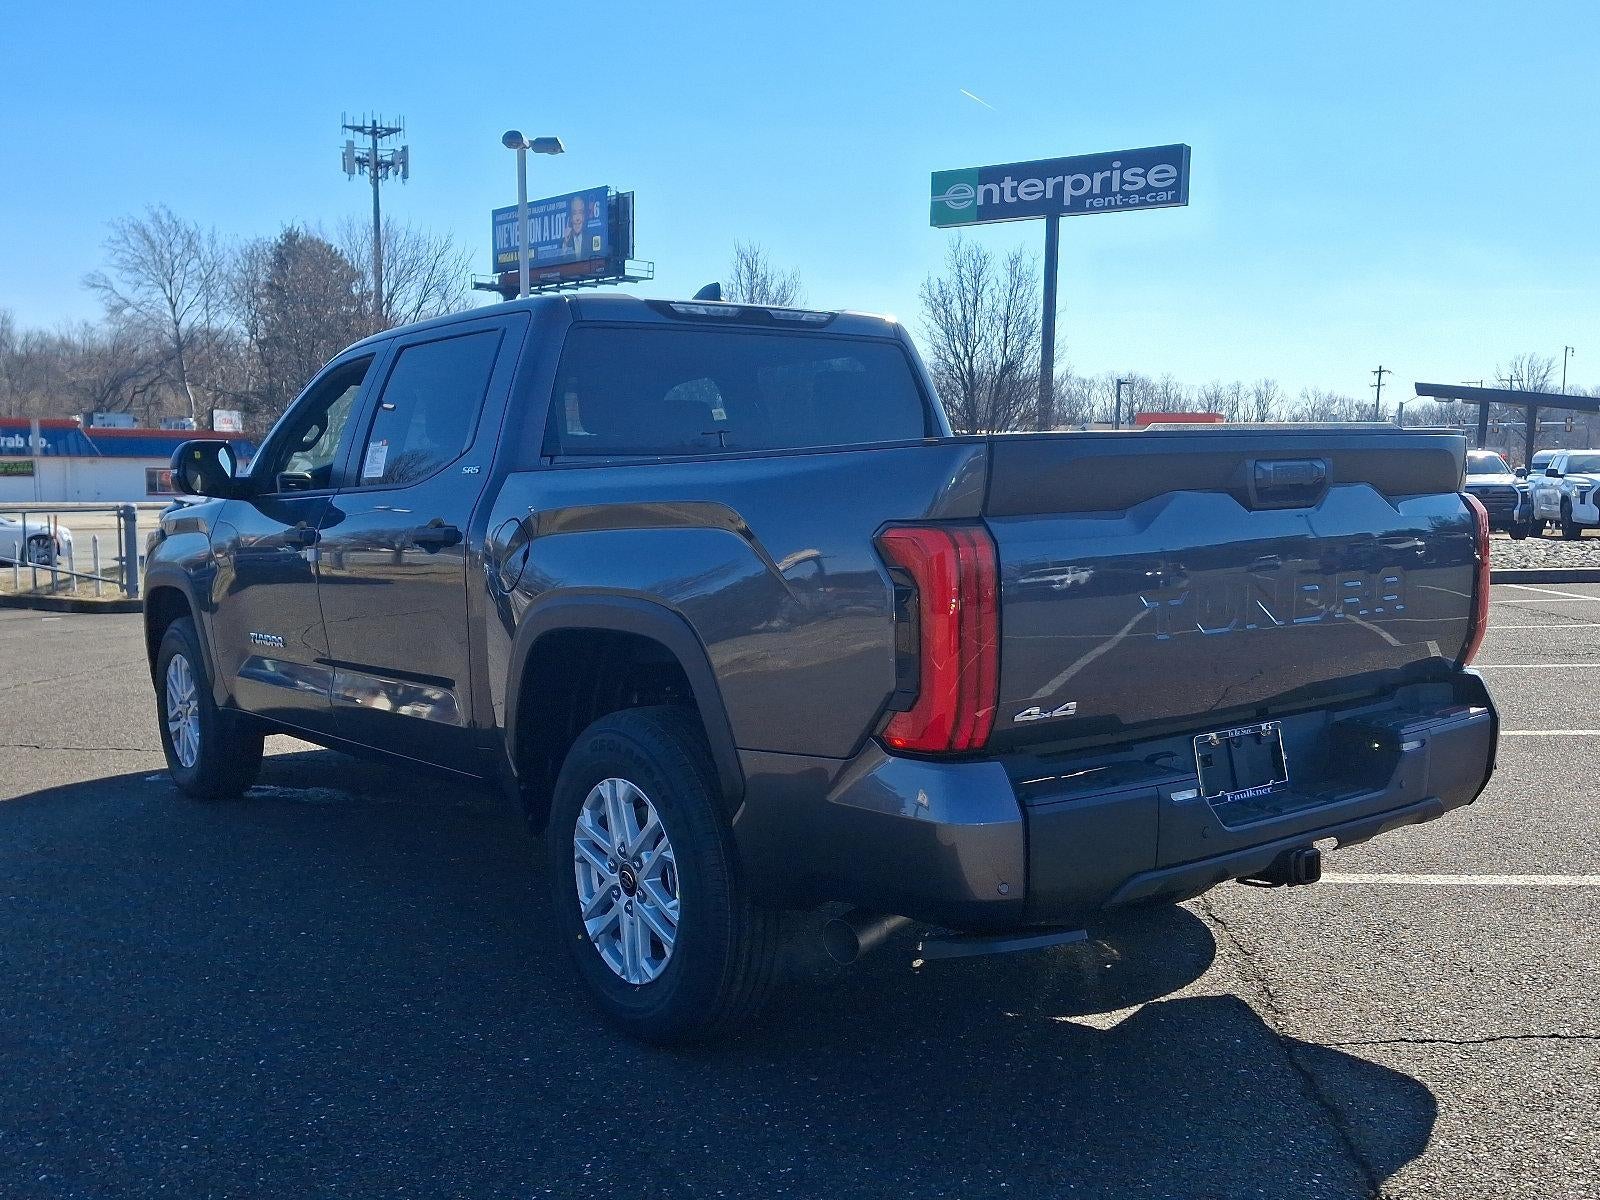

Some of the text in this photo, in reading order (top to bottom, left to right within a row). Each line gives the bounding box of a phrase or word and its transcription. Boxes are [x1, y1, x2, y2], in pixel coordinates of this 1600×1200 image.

[944, 160, 1178, 209] enterprise
[1085, 189, 1176, 208] rent-a-car
[527, 217, 542, 244] ON
[543, 215, 550, 242] A
[551, 211, 567, 240] LOT
[461, 465, 480, 474] SR5
[1138, 566, 1405, 641] TUNDRA
[249, 632, 285, 648] TUNDRA
[1226, 786, 1273, 802] Faulkner
